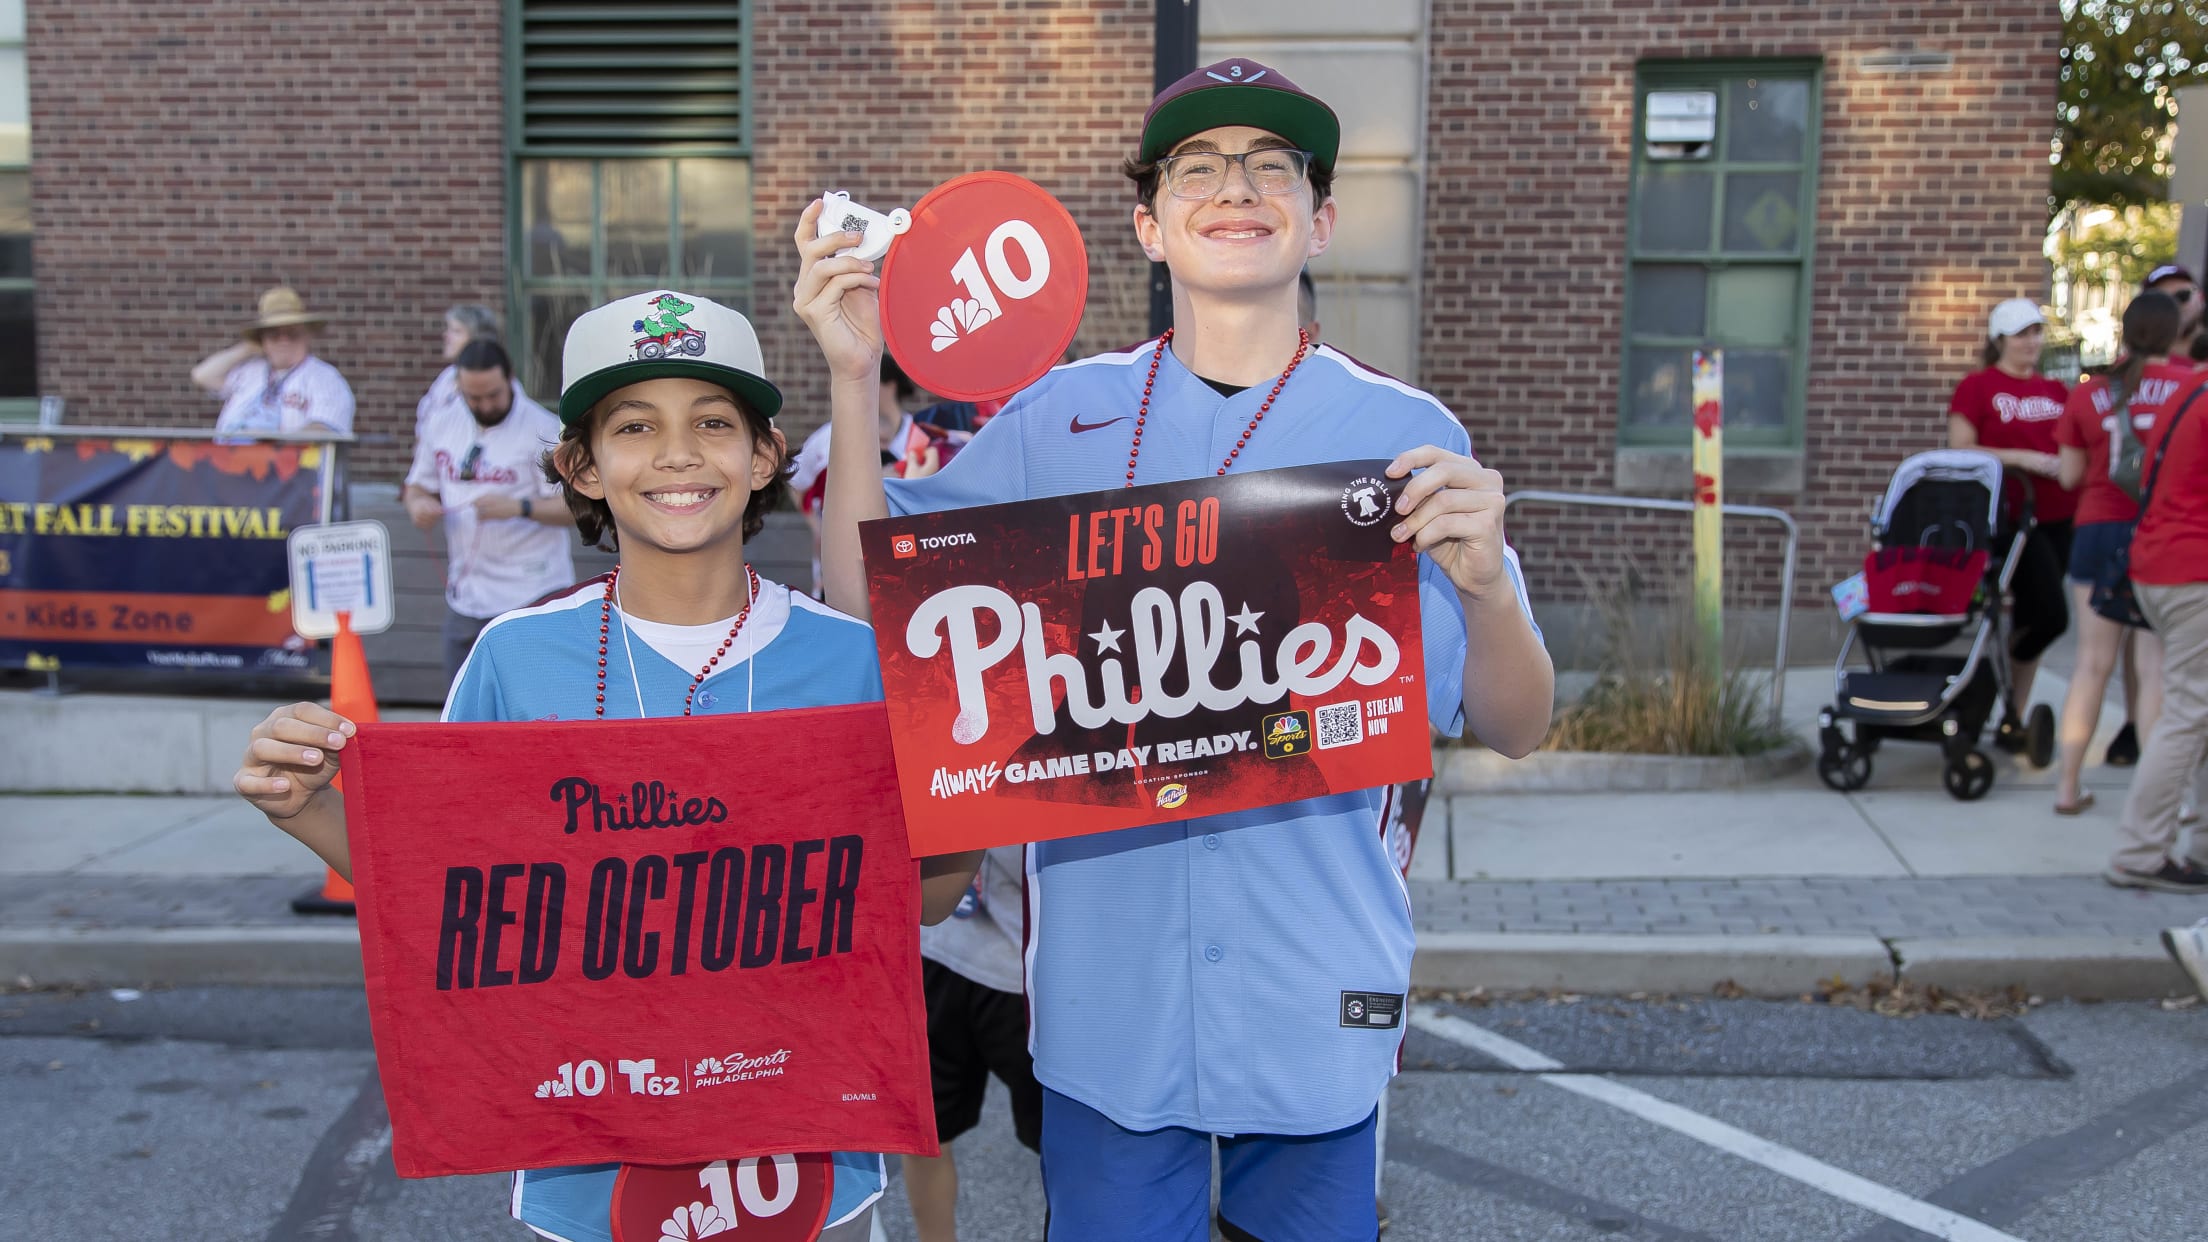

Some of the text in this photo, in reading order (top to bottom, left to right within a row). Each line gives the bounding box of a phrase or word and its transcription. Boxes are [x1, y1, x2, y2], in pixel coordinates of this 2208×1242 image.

[1230, 65, 1243, 77] 3
[950, 219, 1051, 321] 10
[1341, 477, 1389, 509] RING THE BELL
[34, 503, 122, 535] FALL
[127, 505, 290, 538] FESTIVAL
[919, 532, 976, 550] TOYOTA
[1067, 497, 1220, 581] LET'S GO
[25, 604, 193, 631] Kids Zone
[906, 581, 1400, 745] Phillies
[1366, 696, 1404, 717] STREAM
[1267, 729, 1308, 746] Sports
[1368, 718, 1388, 736] NOW
[1004, 754, 1090, 785] GAME
[1095, 745, 1152, 773] DAY
[1156, 730, 1258, 764] READY.
[1133, 769, 1209, 785] LOCATION SPONSOR
[550, 777, 728, 834] Phillies
[1156, 785, 1188, 808] Hatfield
[436, 834, 864, 991] RED OCTOBER
[723, 1049, 792, 1073] Sports
[558, 1059, 606, 1097] 10
[647, 1076, 680, 1096] 62
[695, 1066, 784, 1089] PHILADELPHIA
[699, 1153, 799, 1231] 10
